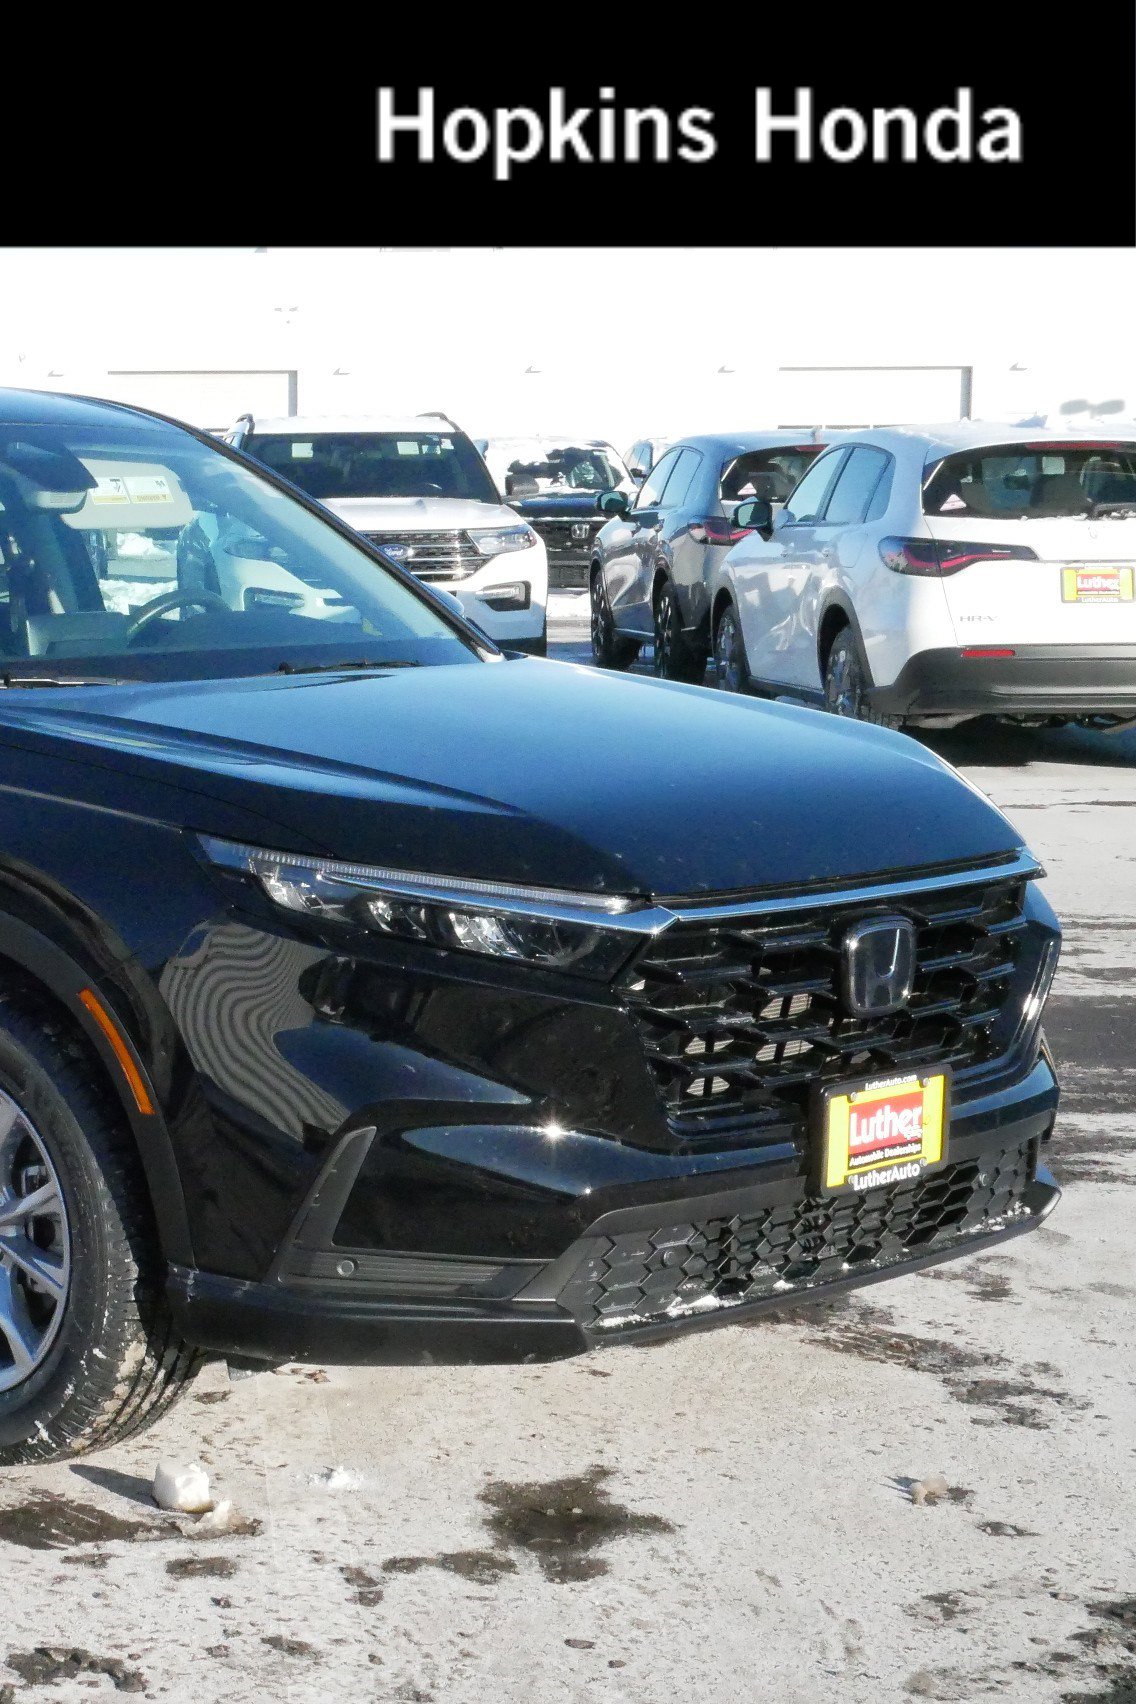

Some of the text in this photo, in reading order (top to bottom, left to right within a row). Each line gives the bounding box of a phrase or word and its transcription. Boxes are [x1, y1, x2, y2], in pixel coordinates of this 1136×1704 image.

[866, 1075, 917, 1091] LutherAuto.com
[850, 1105, 922, 1146] Luther
[853, 1163, 920, 1191] LutherAuto
